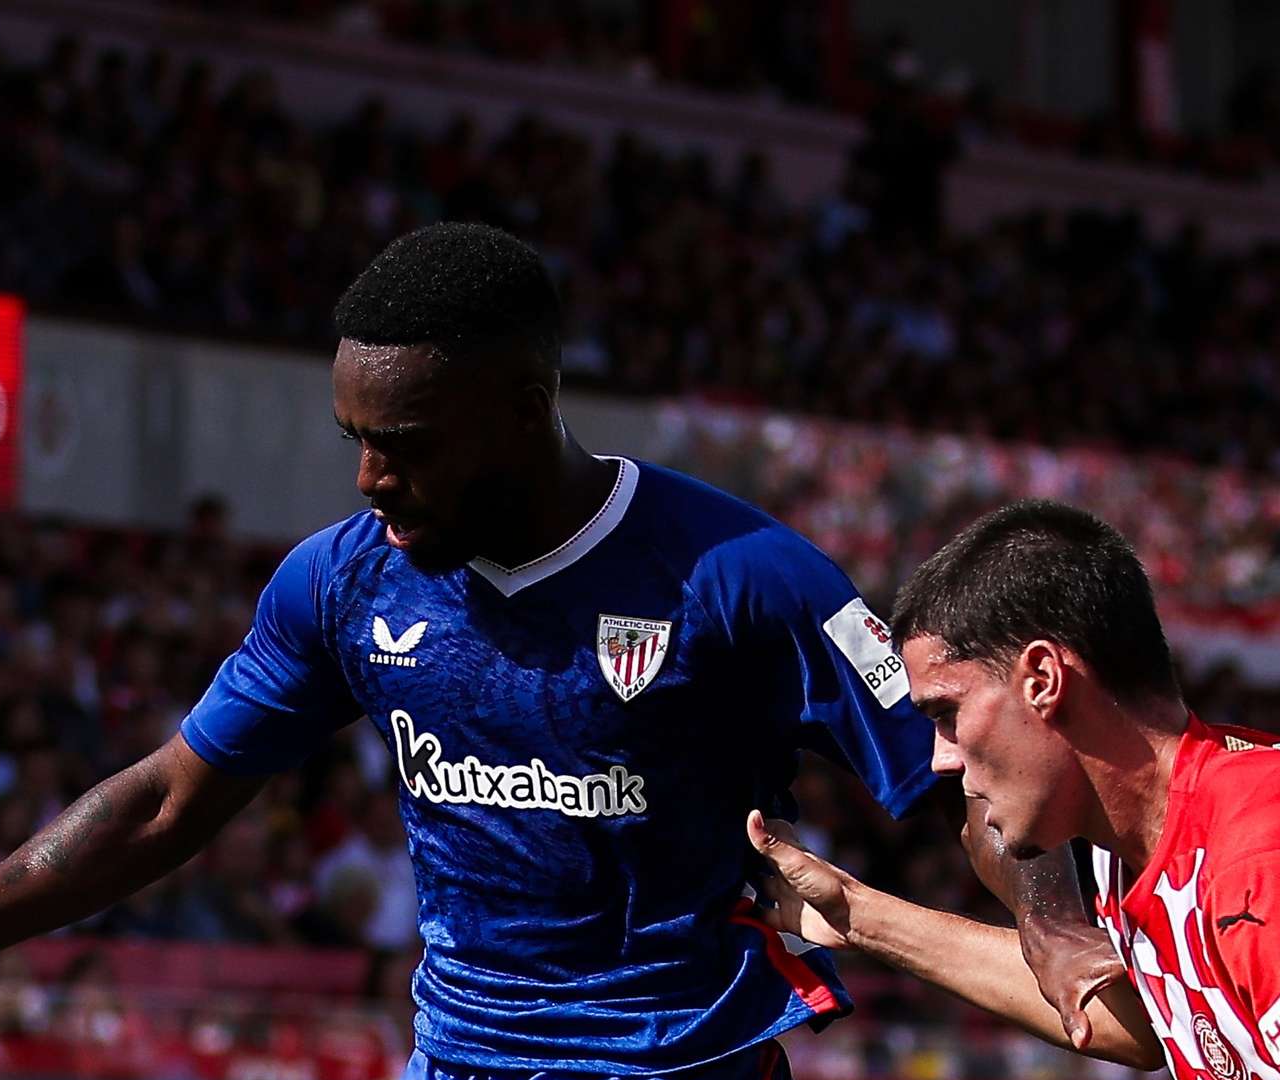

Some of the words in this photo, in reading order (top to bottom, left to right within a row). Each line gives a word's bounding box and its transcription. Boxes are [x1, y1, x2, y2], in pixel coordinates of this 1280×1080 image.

[603, 618, 643, 630] ATHLETIC
[644, 623, 667, 631] CLUB
[369, 653, 418, 668] CASTORE
[865, 655, 902, 690] B2B
[392, 711, 646, 816] Kutxabank
